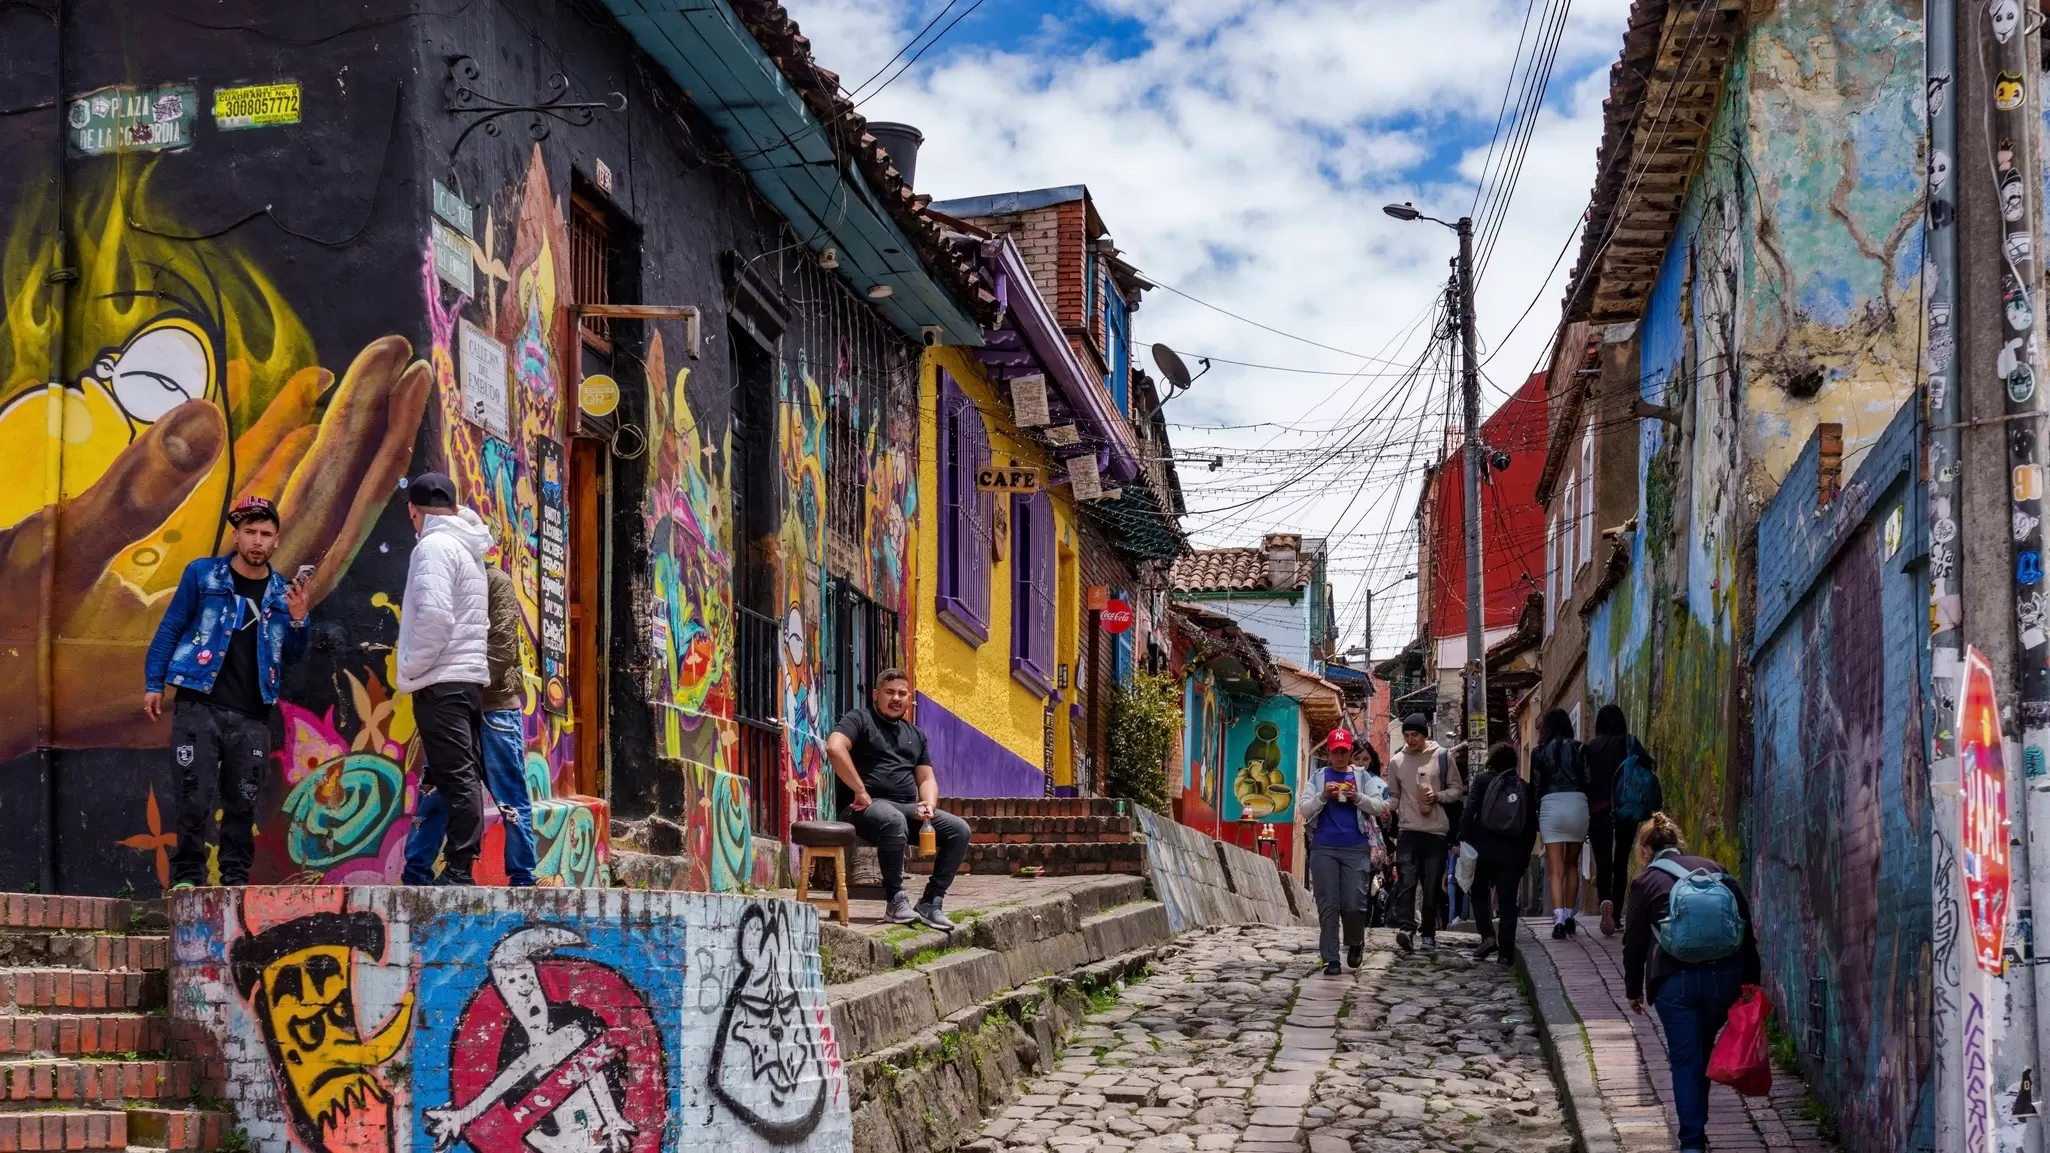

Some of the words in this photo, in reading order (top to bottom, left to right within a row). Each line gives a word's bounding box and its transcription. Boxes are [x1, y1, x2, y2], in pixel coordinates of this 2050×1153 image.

[111, 96, 149, 119] PLAZA
[219, 91, 273, 102] CUADRANTE
[80, 129, 95, 150] DE
[98, 127, 112, 148] LA
[1967, 769, 2003, 865] PARE
[513, 1095, 552, 1123] NO
